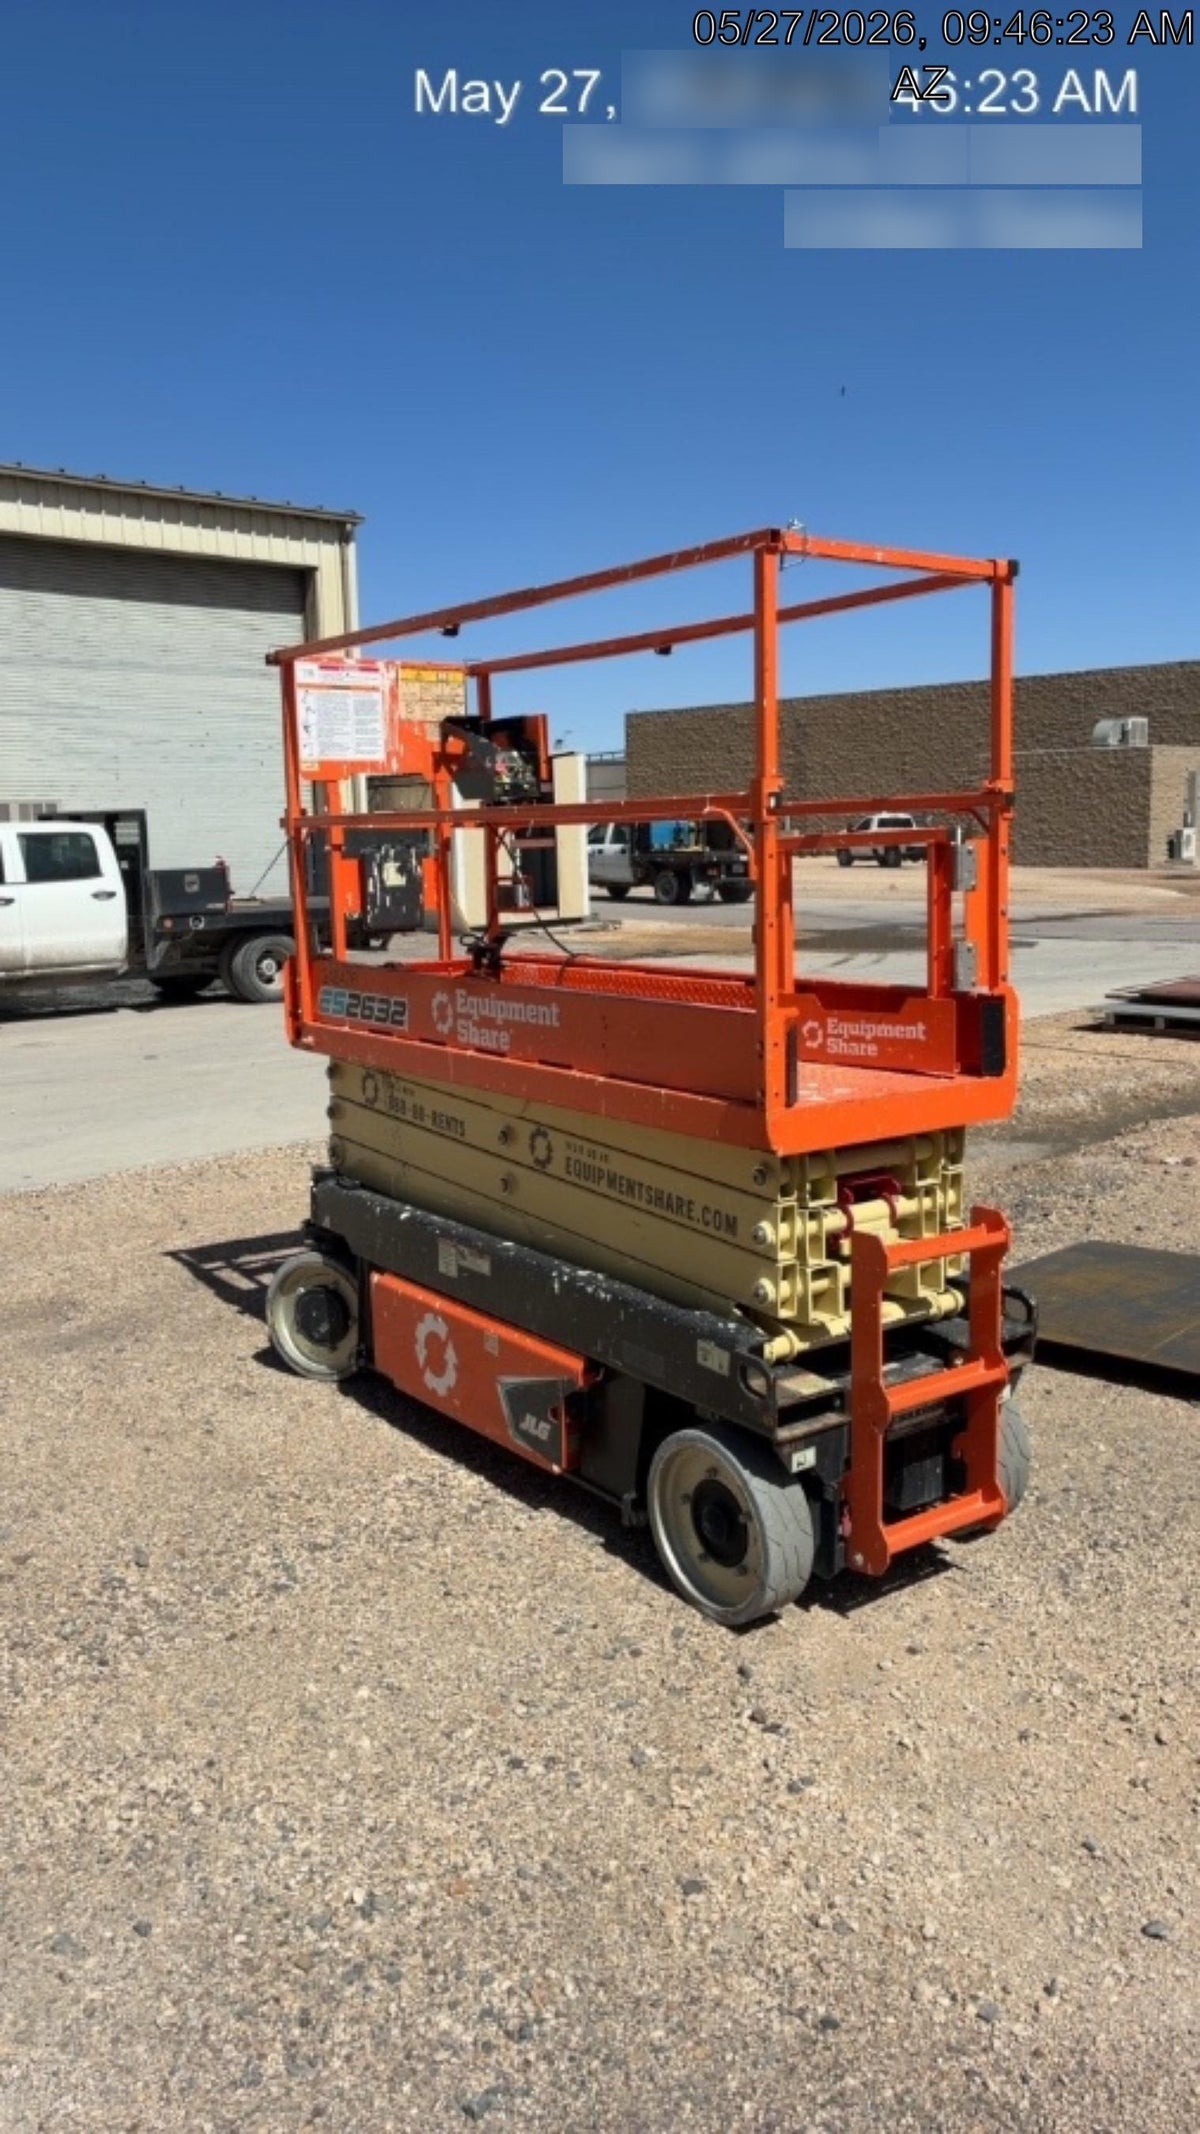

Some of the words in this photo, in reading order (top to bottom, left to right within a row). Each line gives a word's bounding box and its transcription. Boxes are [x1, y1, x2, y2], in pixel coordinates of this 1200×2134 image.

[455, 988, 560, 1027] Equipment
[456, 1022, 510, 1050] Share
[826, 1017, 926, 1041] Equipment
[826, 1037, 878, 1057] Share
[565, 1156, 739, 1237] EQUIPMENTSHARE.COM
[519, 1412, 551, 1441] JLG
